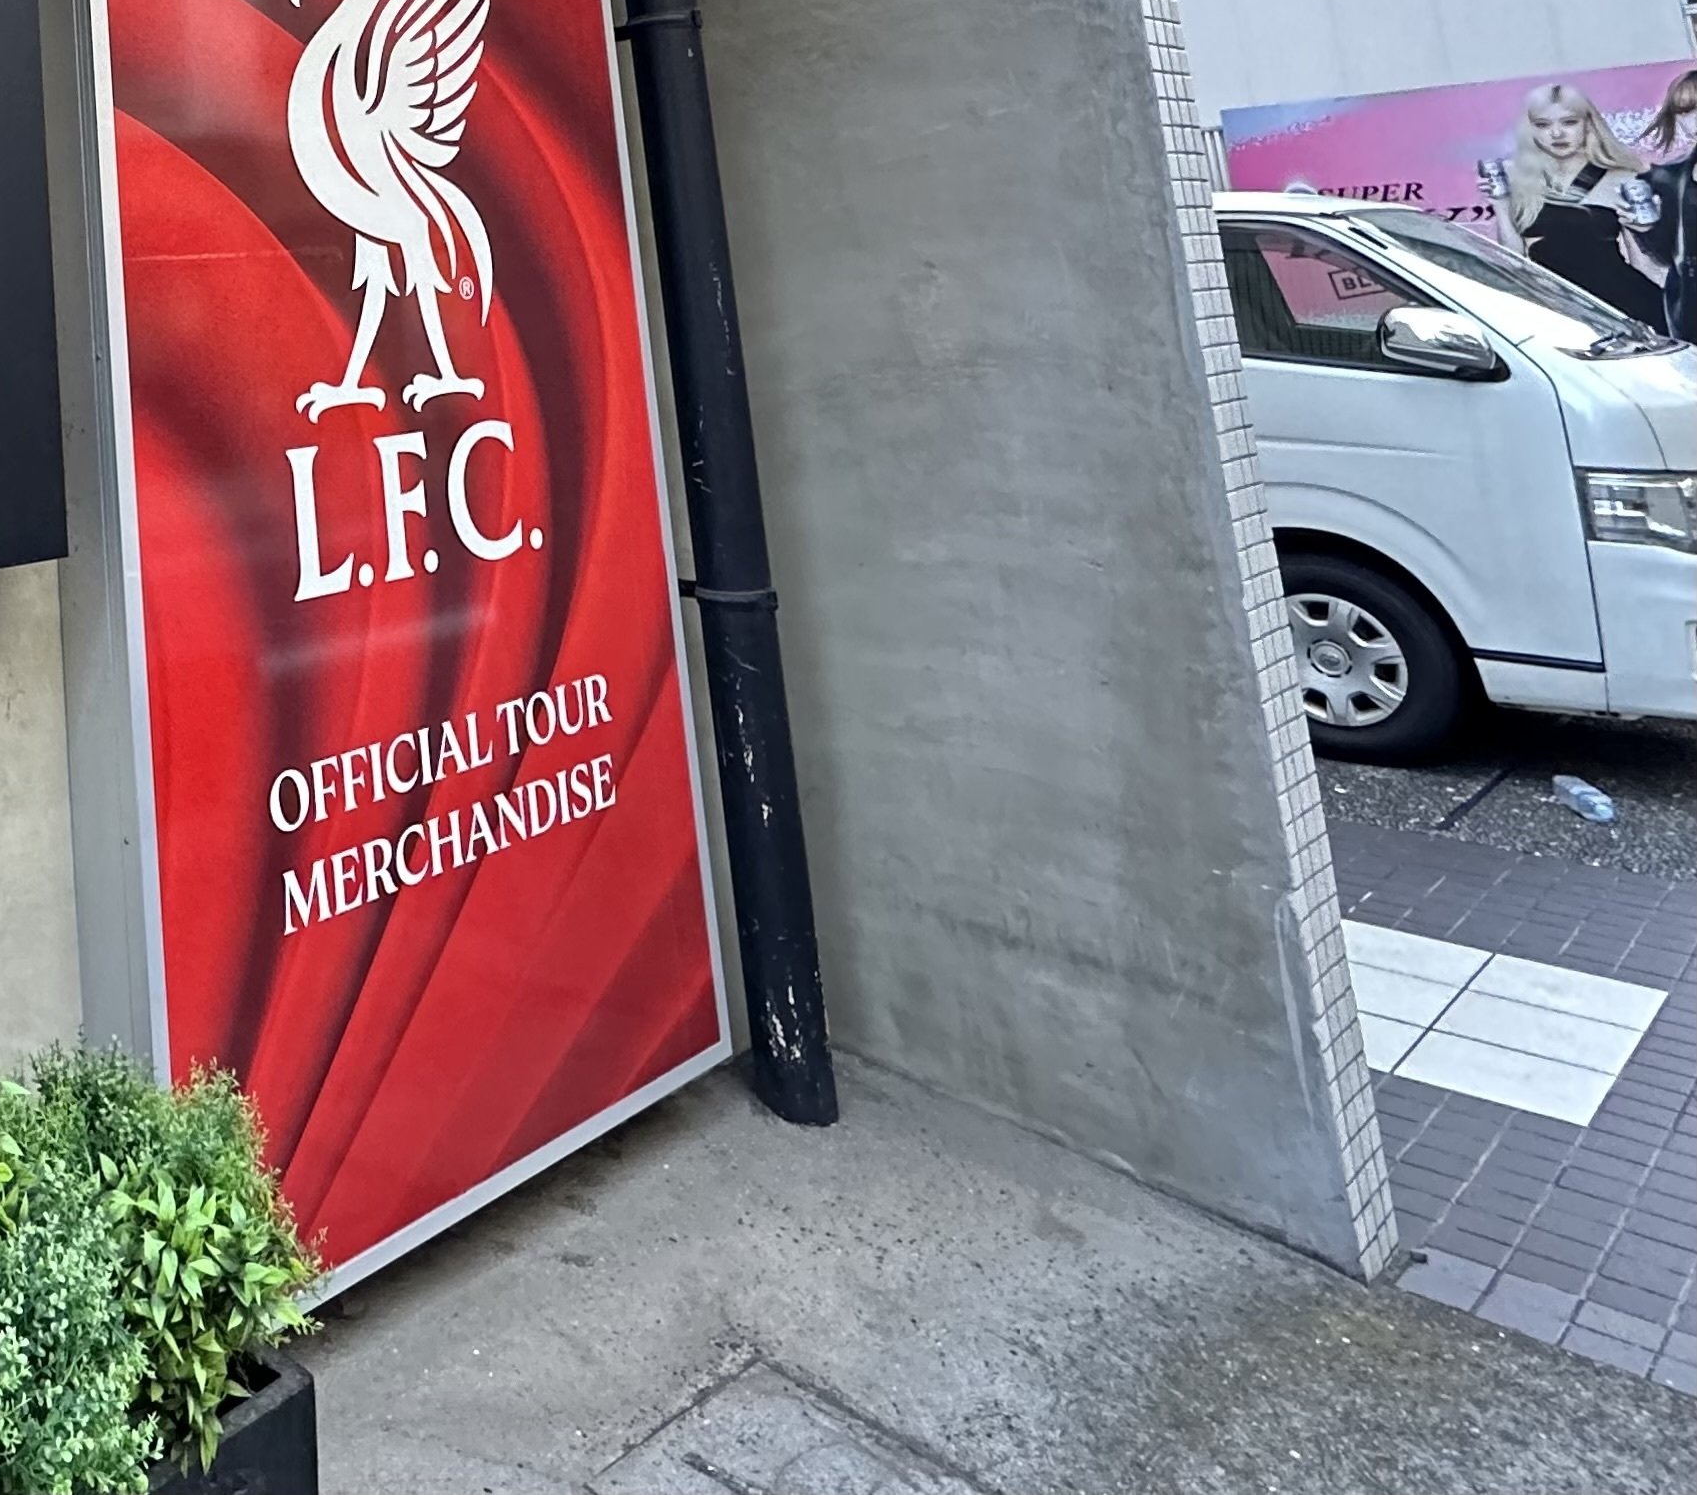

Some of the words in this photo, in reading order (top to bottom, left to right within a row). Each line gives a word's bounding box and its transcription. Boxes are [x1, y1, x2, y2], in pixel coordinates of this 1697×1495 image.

[285, 419, 544, 602] L.F.C.
[269, 712, 494, 833] OFFICIAL
[495, 672, 613, 755] TOUR
[281, 753, 618, 936] MERCHANDISE
